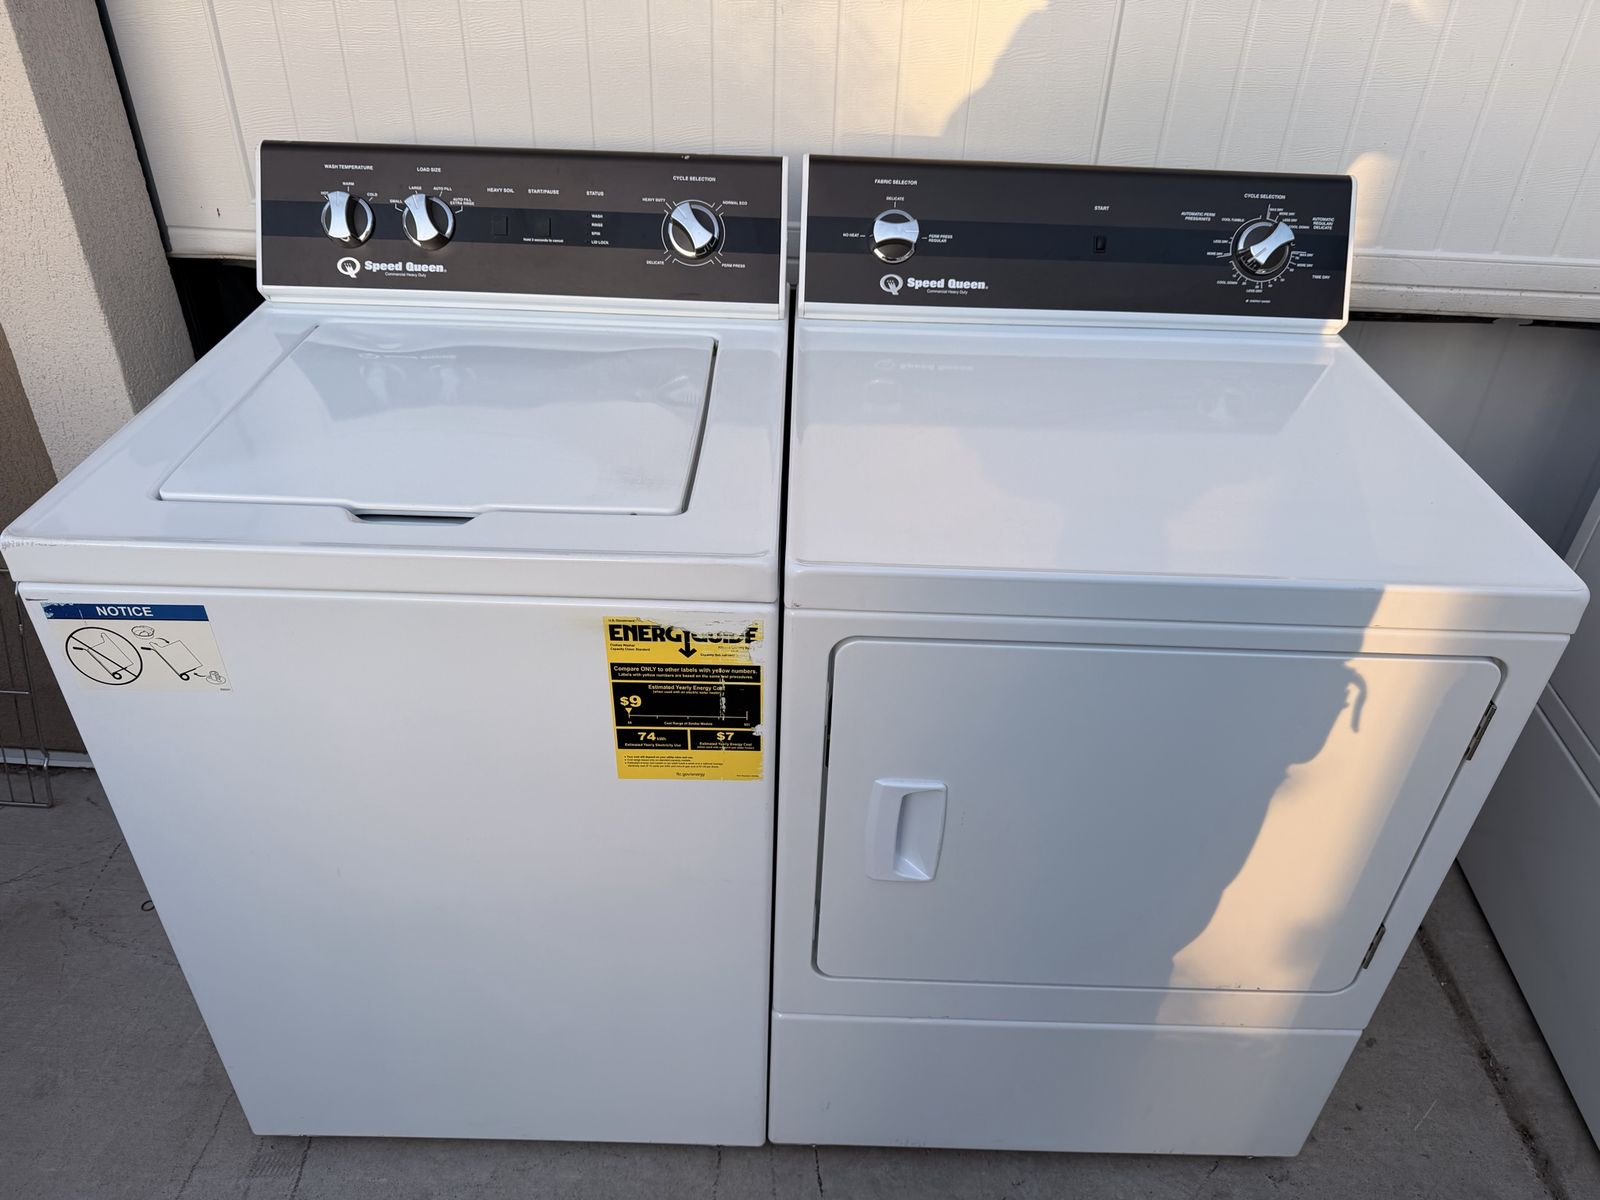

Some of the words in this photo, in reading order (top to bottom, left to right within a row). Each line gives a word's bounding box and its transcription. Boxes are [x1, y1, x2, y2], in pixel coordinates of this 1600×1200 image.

[364, 260, 402, 272] Speed
[405, 262, 444, 273] Queen
[907, 277, 945, 290] Speed
[947, 278, 986, 290] Queen
[96, 605, 154, 617] NOTICE
[620, 695, 642, 707] $9
[638, 732, 656, 741] 74
[716, 731, 734, 741] $7
